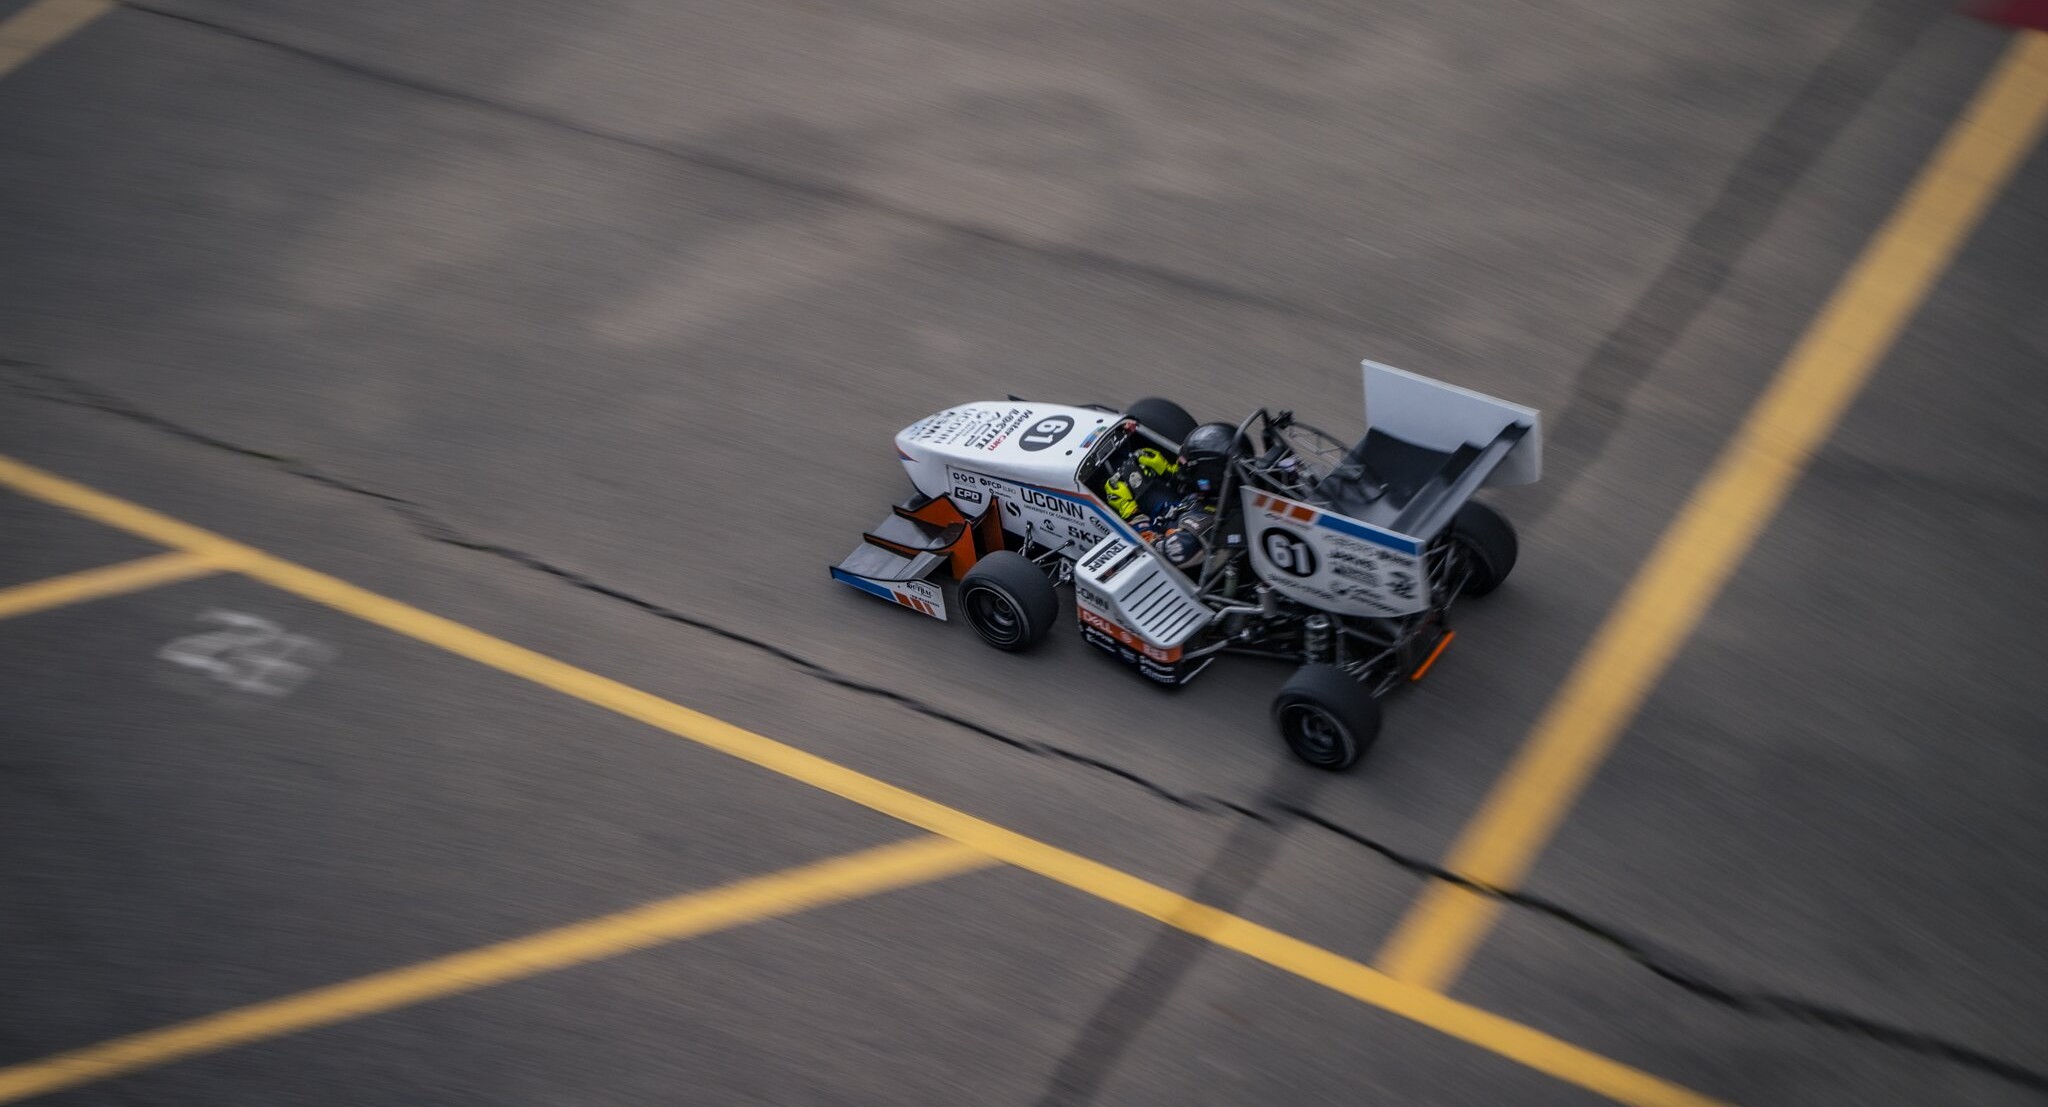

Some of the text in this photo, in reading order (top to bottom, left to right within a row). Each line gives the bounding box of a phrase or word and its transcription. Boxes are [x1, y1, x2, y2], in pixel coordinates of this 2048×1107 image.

[932, 408, 978, 444] UCONN
[975, 408, 1020, 450] LOCTITE
[1023, 418, 1063, 445] 61
[957, 490, 979, 501] CPD
[987, 480, 1002, 489] FCP
[1020, 487, 1084, 520] UCONN
[1088, 542, 1128, 573] TRUMPF
[1267, 534, 1312, 575] 61
